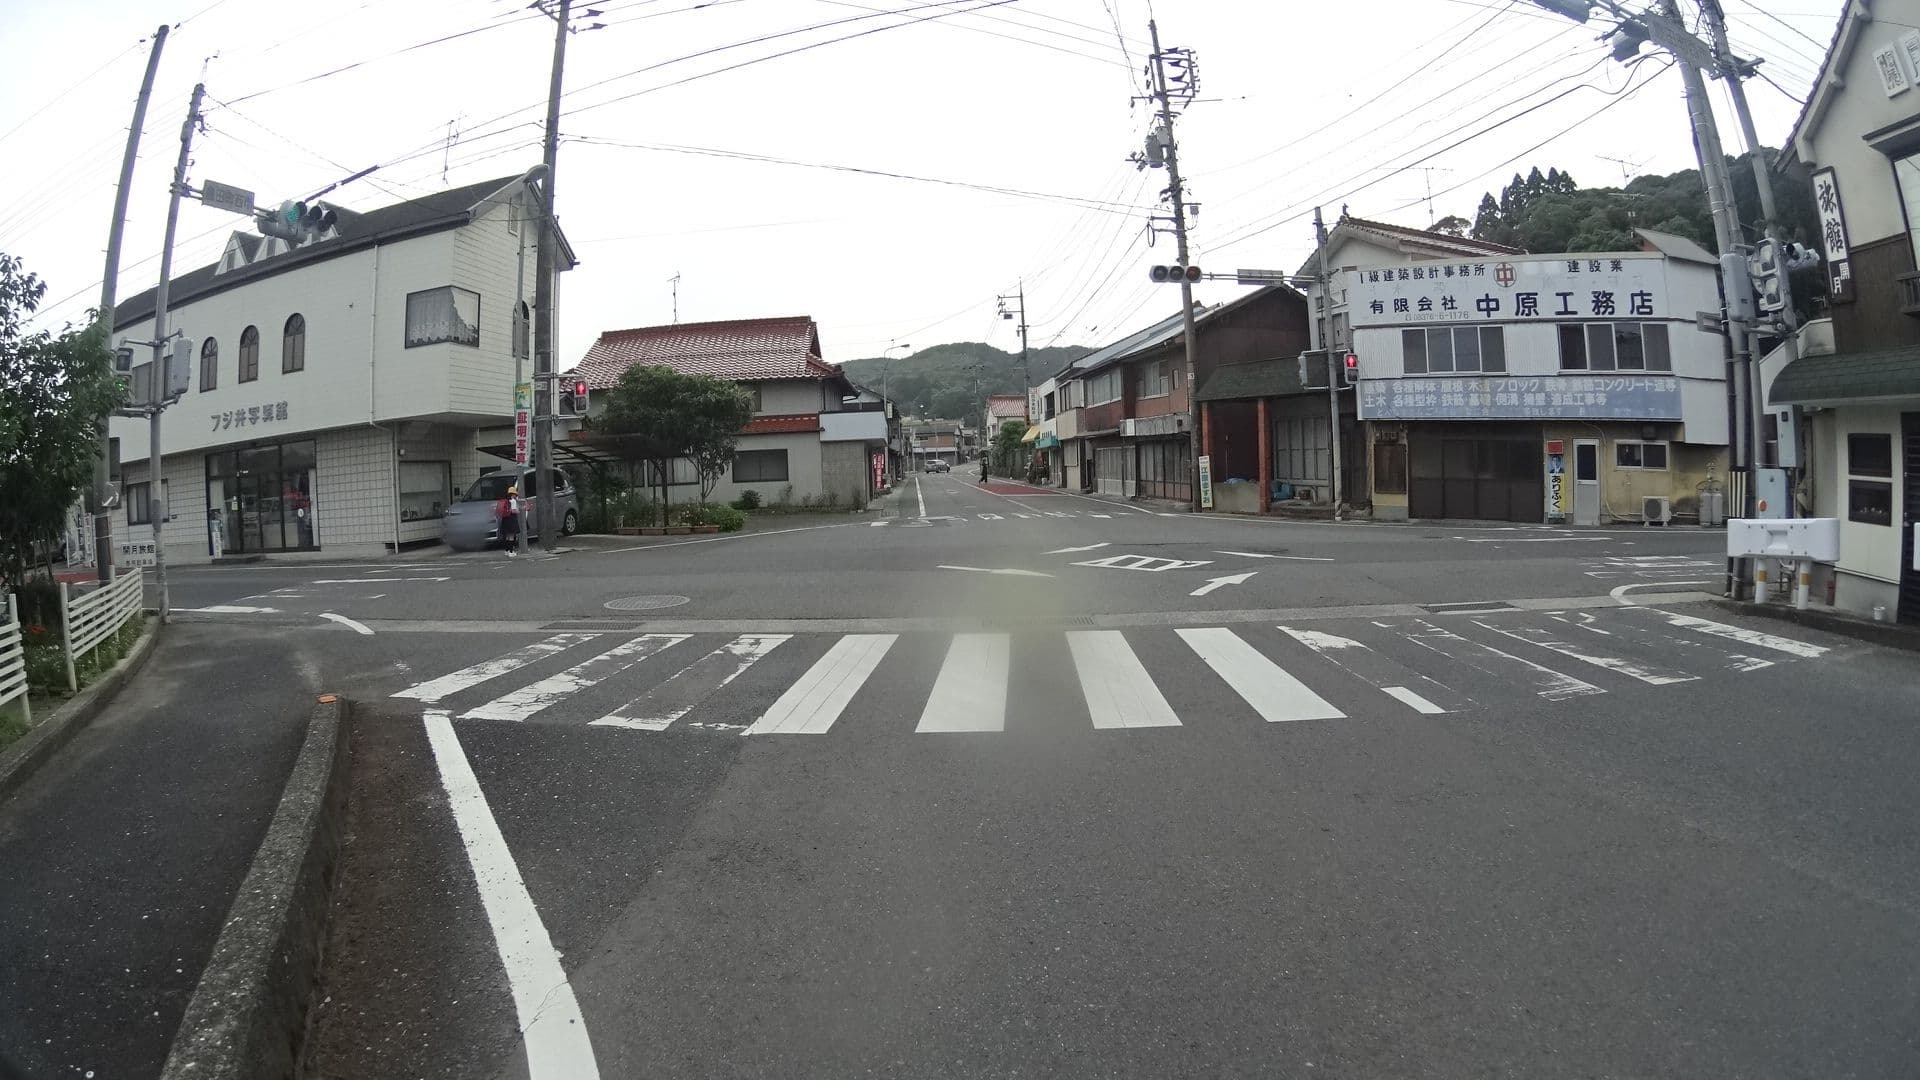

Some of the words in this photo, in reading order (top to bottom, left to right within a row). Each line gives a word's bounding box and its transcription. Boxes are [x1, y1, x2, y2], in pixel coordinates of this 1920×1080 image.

[1818, 179, 1844, 254] 旅館
[1567, 259, 1623, 273] 建設業
[1369, 295, 1458, 315] 有限会社
[1476, 290, 1653, 318] 中原工務店
[211, 400, 288, 432] フジ井写真館
[1364, 394, 1387, 408] 土木
[517, 412, 528, 464] 証明写真
